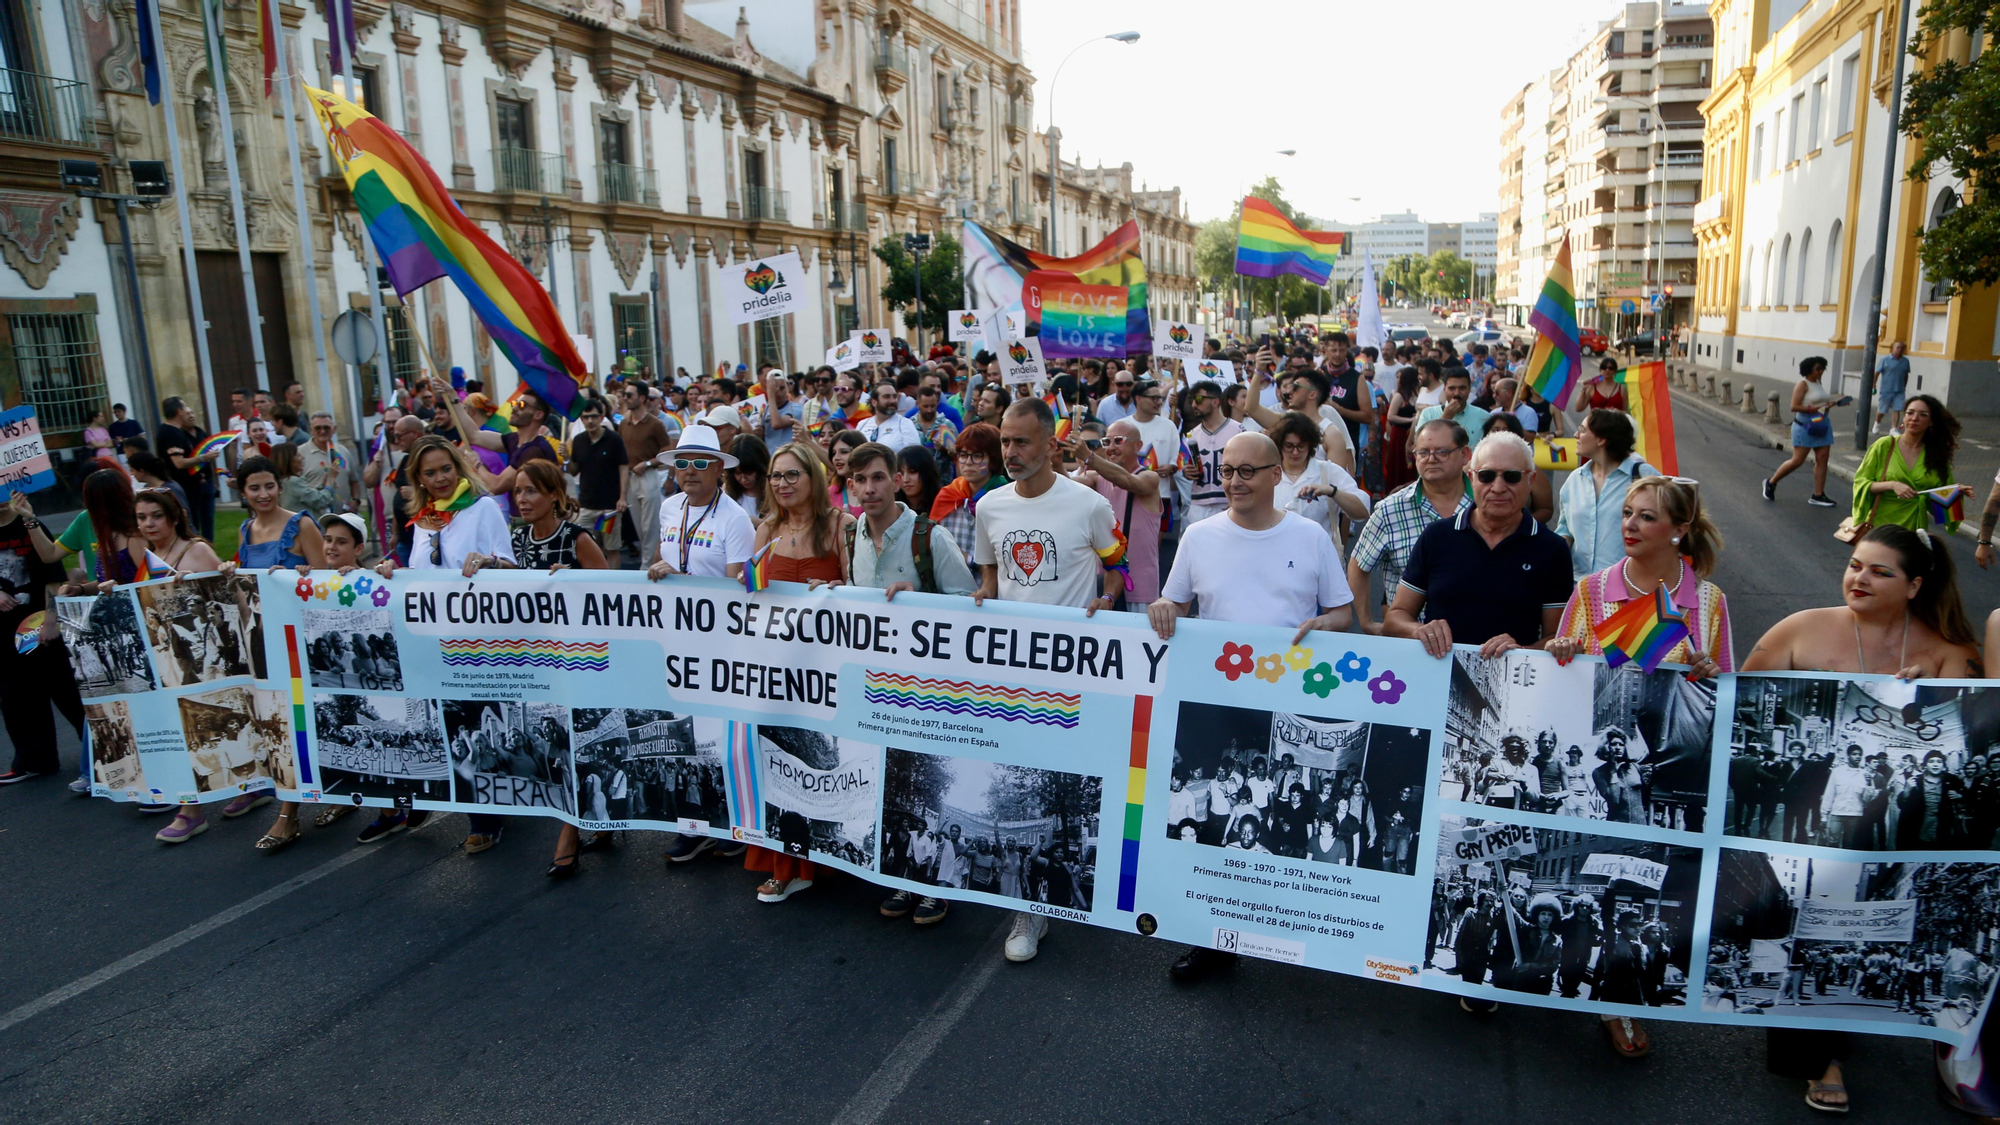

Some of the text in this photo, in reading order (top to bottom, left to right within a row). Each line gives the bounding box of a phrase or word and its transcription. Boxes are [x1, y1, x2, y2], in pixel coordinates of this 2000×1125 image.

[743, 292, 792, 313] pridelia
[1058, 291, 1118, 318] LOVE
[1077, 314, 1095, 329] IS
[1058, 326, 1116, 352] LOVE
[1163, 343, 1194, 354] pridelia
[860, 349, 885, 357] pridelia
[1009, 364, 1039, 377] pridelia
[22, 416, 32, 434] A
[0, 466, 33, 490] TRANS
[404, 582, 1169, 684] EN CÓRDOBA AMAR NO SE ESCONDE: SE CELEBRA Y
[469, 672, 485, 681] junio
[527, 682, 550, 690] libertad
[665, 654, 838, 709] SE DEFIENDE
[872, 711, 984, 734] 26 de junio de 1977, Barcelona
[858, 721, 999, 749] Primera gran manifestación en España
[331, 755, 410, 775] DE CASTILLA
[769, 755, 869, 793] HOMOSEXUAL
[578, 819, 630, 830] PATROCINAN:
[1455, 839, 1485, 860] GAY
[1223, 858, 1246, 869] 1969
[1253, 863, 1276, 874] 1970
[1283, 867, 1307, 879] 1971,
[1309, 871, 1330, 882] New
[1331, 874, 1352, 885] York
[1193, 865, 1380, 904] Primeras marchas por la liberación sexual
[1029, 903, 1090, 923] COLABORAN:
[1186, 890, 1385, 931] El origen del orgullo fueron los disturbios de
[1807, 907, 1904, 917] CHRISTOPHER STREET
[1210, 907, 1355, 940] Stonewall el 28 de junio de 1969
[1833, 919, 1881, 927] LIBERATION
[1884, 919, 1900, 927] DAY
[1843, 930, 1864, 939] 1970
